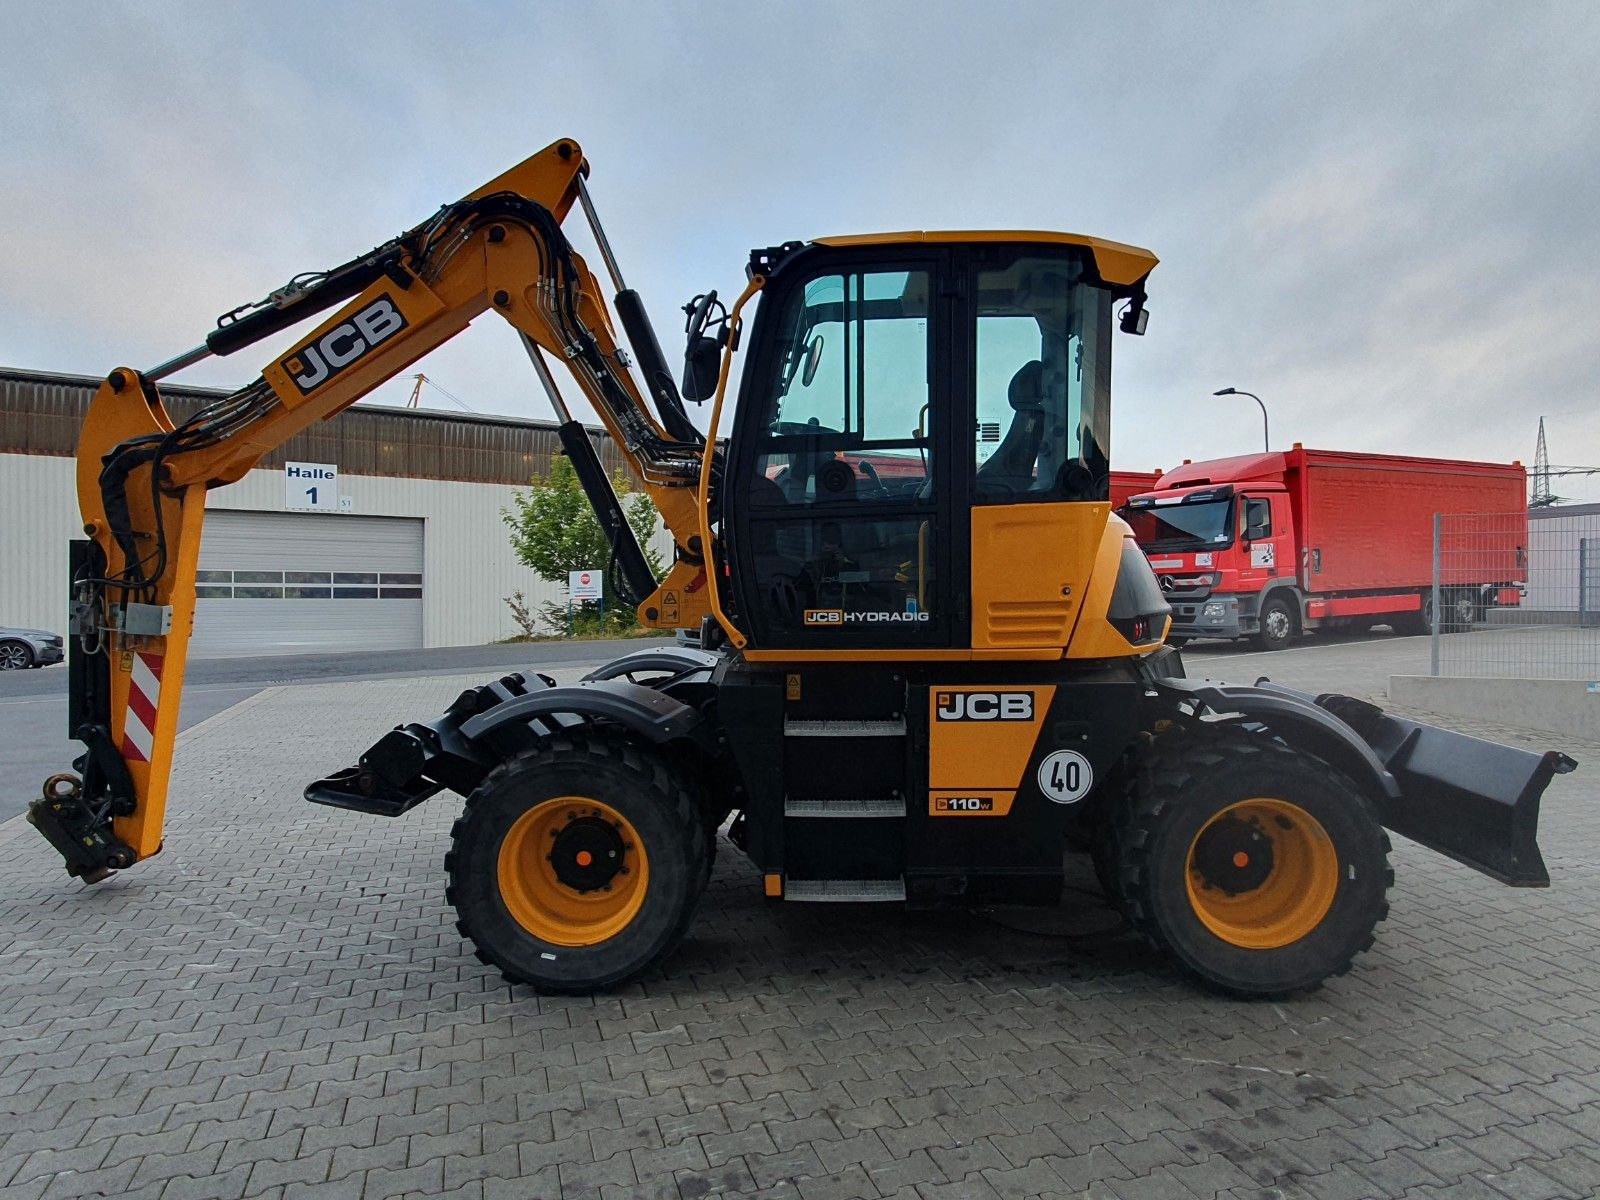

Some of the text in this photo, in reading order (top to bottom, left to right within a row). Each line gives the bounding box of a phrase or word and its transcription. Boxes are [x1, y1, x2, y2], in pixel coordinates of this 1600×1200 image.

[297, 300, 402, 389] JCB
[287, 467, 335, 480] Halle
[306, 487, 317, 504] 1
[808, 612, 930, 622] JCB HYDRADIG
[938, 693, 1033, 720] JCB
[1050, 761, 1080, 793] 40
